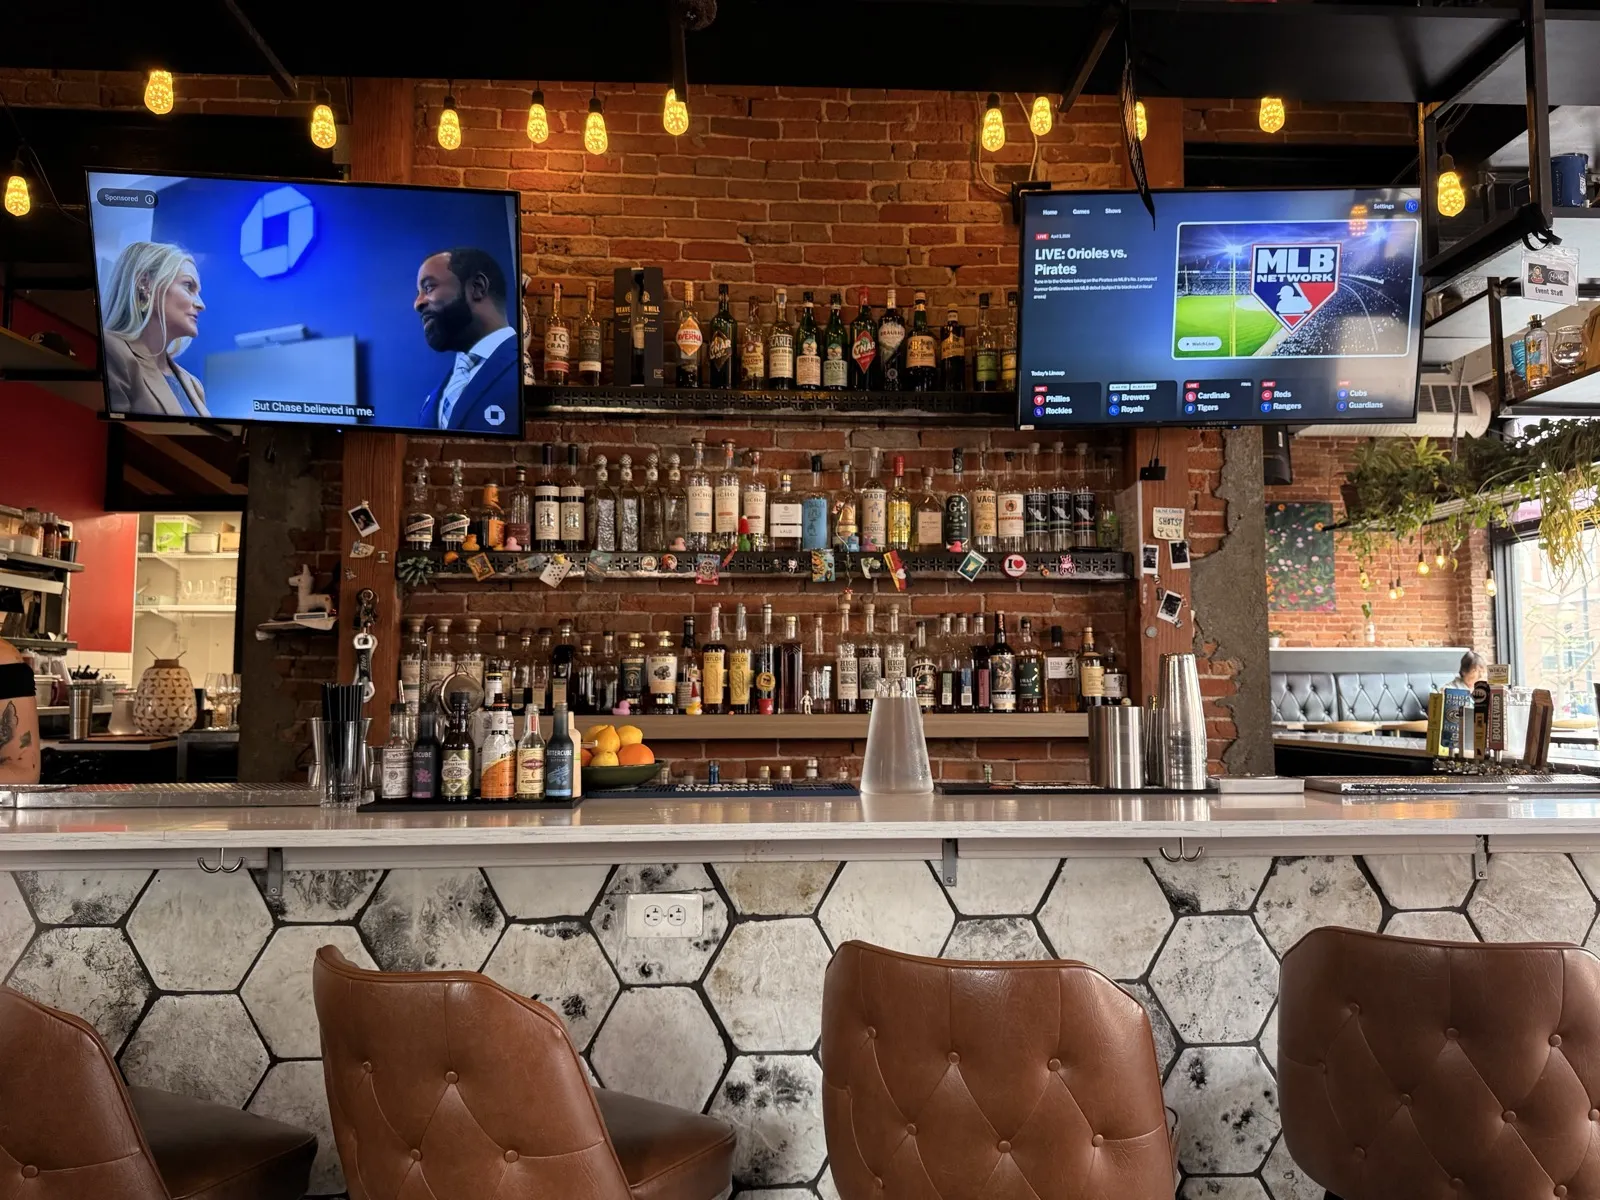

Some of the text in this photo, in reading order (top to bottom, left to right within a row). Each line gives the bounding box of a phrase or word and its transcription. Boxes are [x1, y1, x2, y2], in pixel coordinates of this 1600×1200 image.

[104, 193, 138, 203] Sponsored
[1373, 202, 1394, 211] Settings
[1035, 247, 1127, 260] LIVE: Orioles vs.
[1256, 248, 1336, 274] MLB
[1034, 263, 1077, 275] Pirates
[1256, 274, 1334, 283] NETWORK
[678, 333, 701, 341] AVERNA
[852, 341, 876, 359] CYNAR
[1197, 391, 1231, 399] Cardinals
[1274, 390, 1292, 398] Reds
[254, 400, 375, 416] But Chase believed in me.
[1121, 405, 1144, 413] Royals
[1197, 404, 1219, 412] Tigers
[1273, 402, 1302, 410] Rangers
[1493, 695, 1501, 740] BOULEVARD
